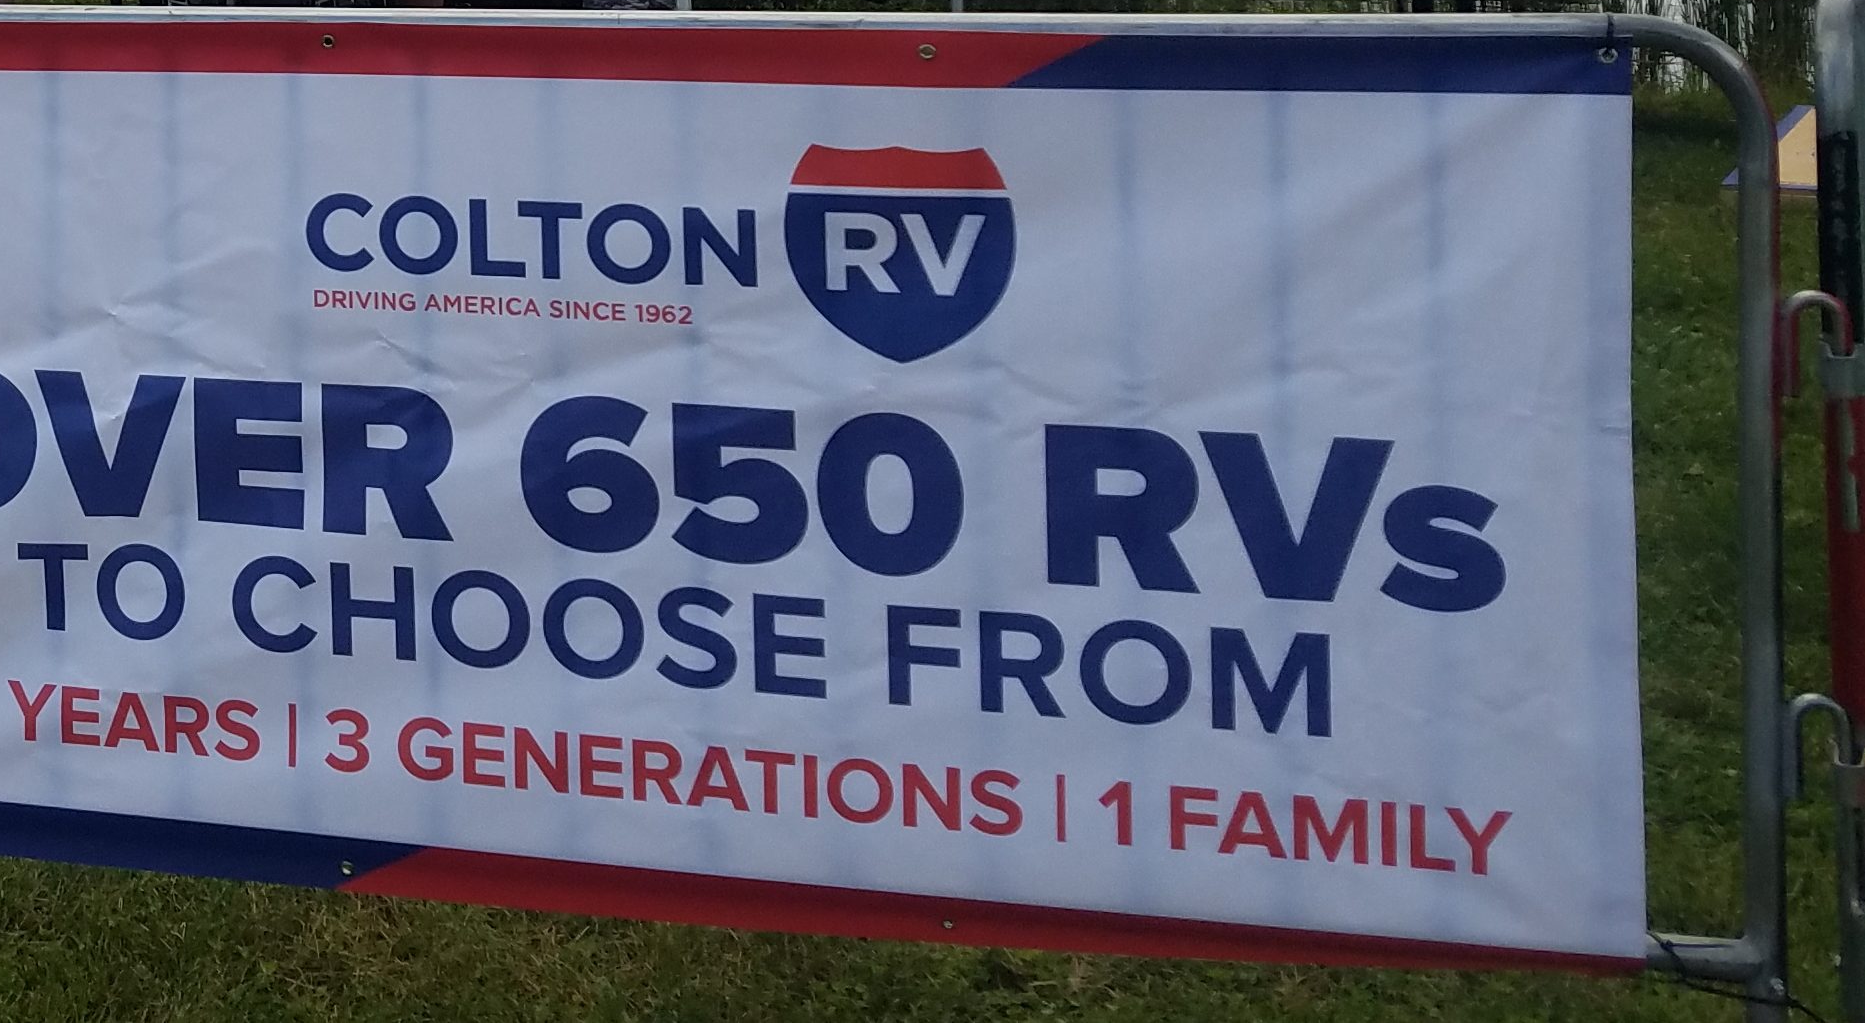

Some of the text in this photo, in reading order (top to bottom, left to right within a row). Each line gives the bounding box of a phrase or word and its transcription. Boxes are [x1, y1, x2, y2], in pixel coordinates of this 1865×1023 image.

[305, 192, 986, 297] COLTON RV
[313, 289, 693, 325] DRIVING AMERICA SINCE 1962
[520, 395, 965, 577] 650
[1044, 423, 1508, 612] RVs
[17, 542, 1332, 737] TO CHOOSE FROM
[8, 680, 261, 760] YEARS
[324, 708, 370, 774] 3
[397, 716, 1023, 836] GENERATIONS
[1099, 780, 1133, 847] 1
[1169, 784, 1513, 876] FAMILY
